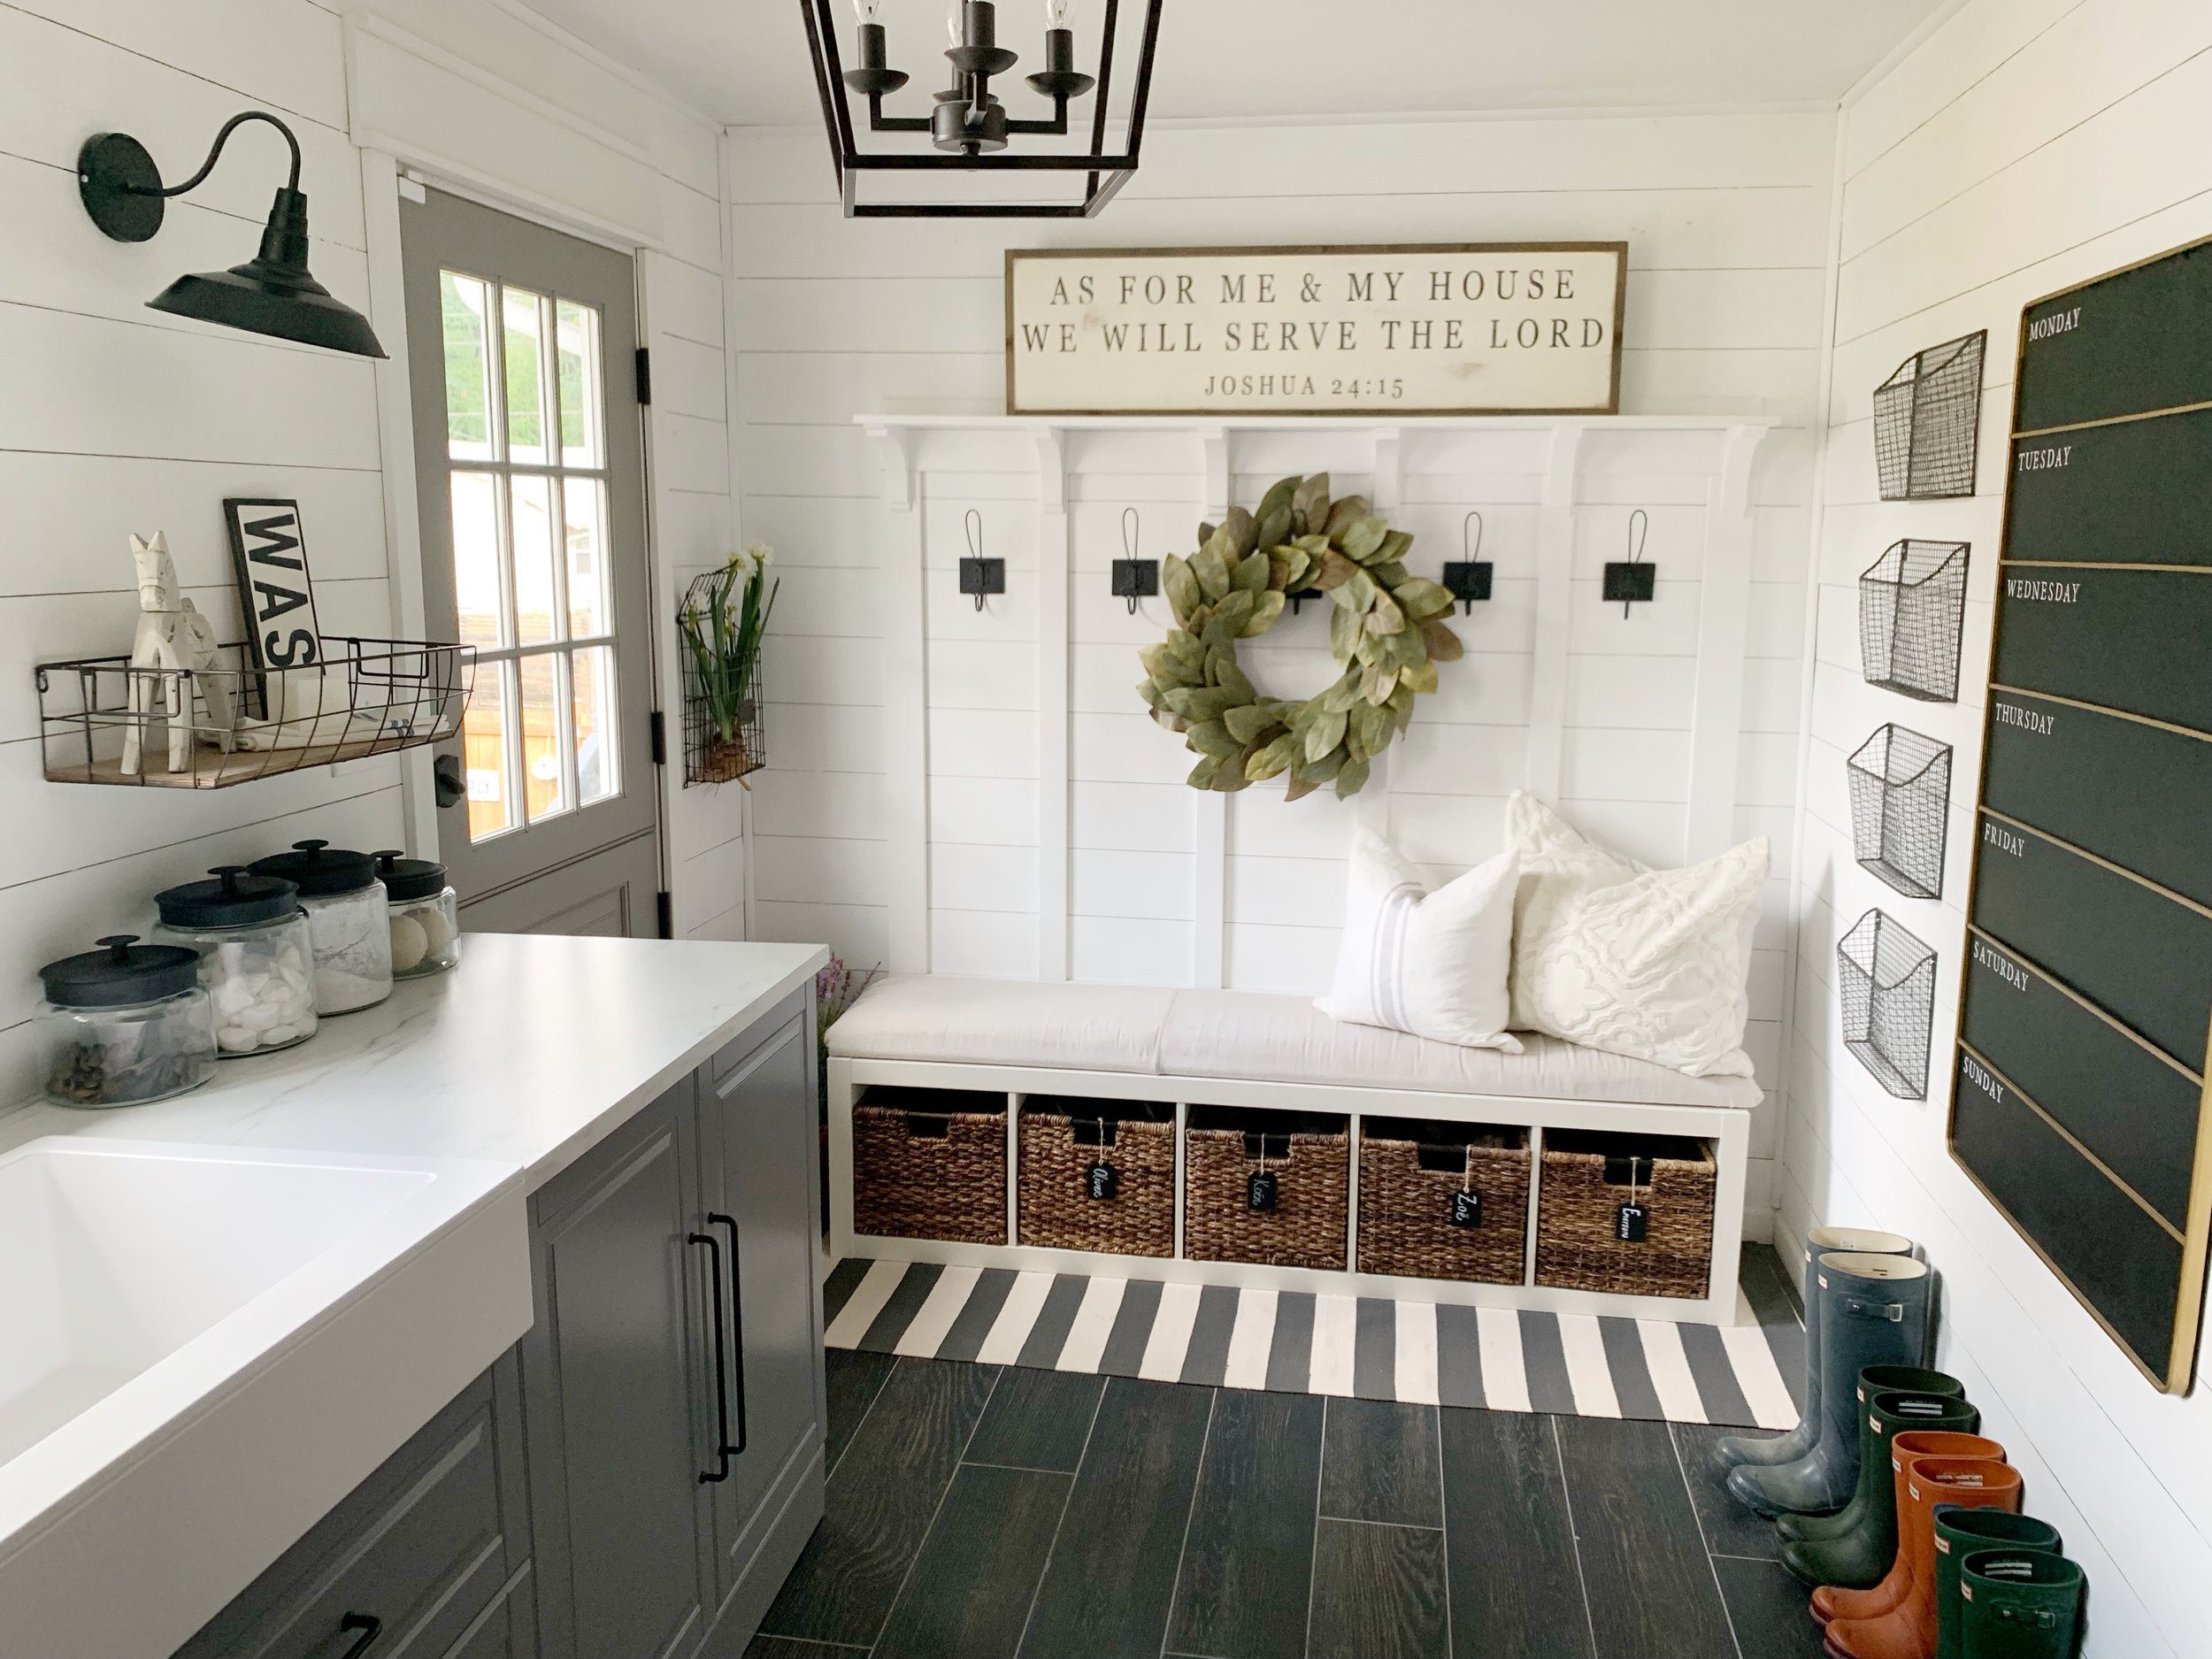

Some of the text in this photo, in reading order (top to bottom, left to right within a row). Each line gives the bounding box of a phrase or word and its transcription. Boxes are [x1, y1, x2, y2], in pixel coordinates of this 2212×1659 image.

[1049, 269, 1575, 304] AS FOR ME & MY HOUSE
[1022, 319, 1603, 353] WE WILL SERVE THE LORD
[2029, 307, 2081, 342] MONDAY
[1205, 375, 1403, 398] JOSHUA 24:15
[2018, 446, 2071, 472] TUESDAY
[243, 513, 317, 668] WAS
[2008, 579, 2079, 603] WEDNESDAY
[1996, 703, 2055, 734] THURSDAY
[1984, 823, 2024, 857] FRIDAY
[1973, 941, 2029, 991] SATURDAY
[1962, 1056, 2004, 1103] SUNDAY
[1455, 1194, 1478, 1221] Zoë
